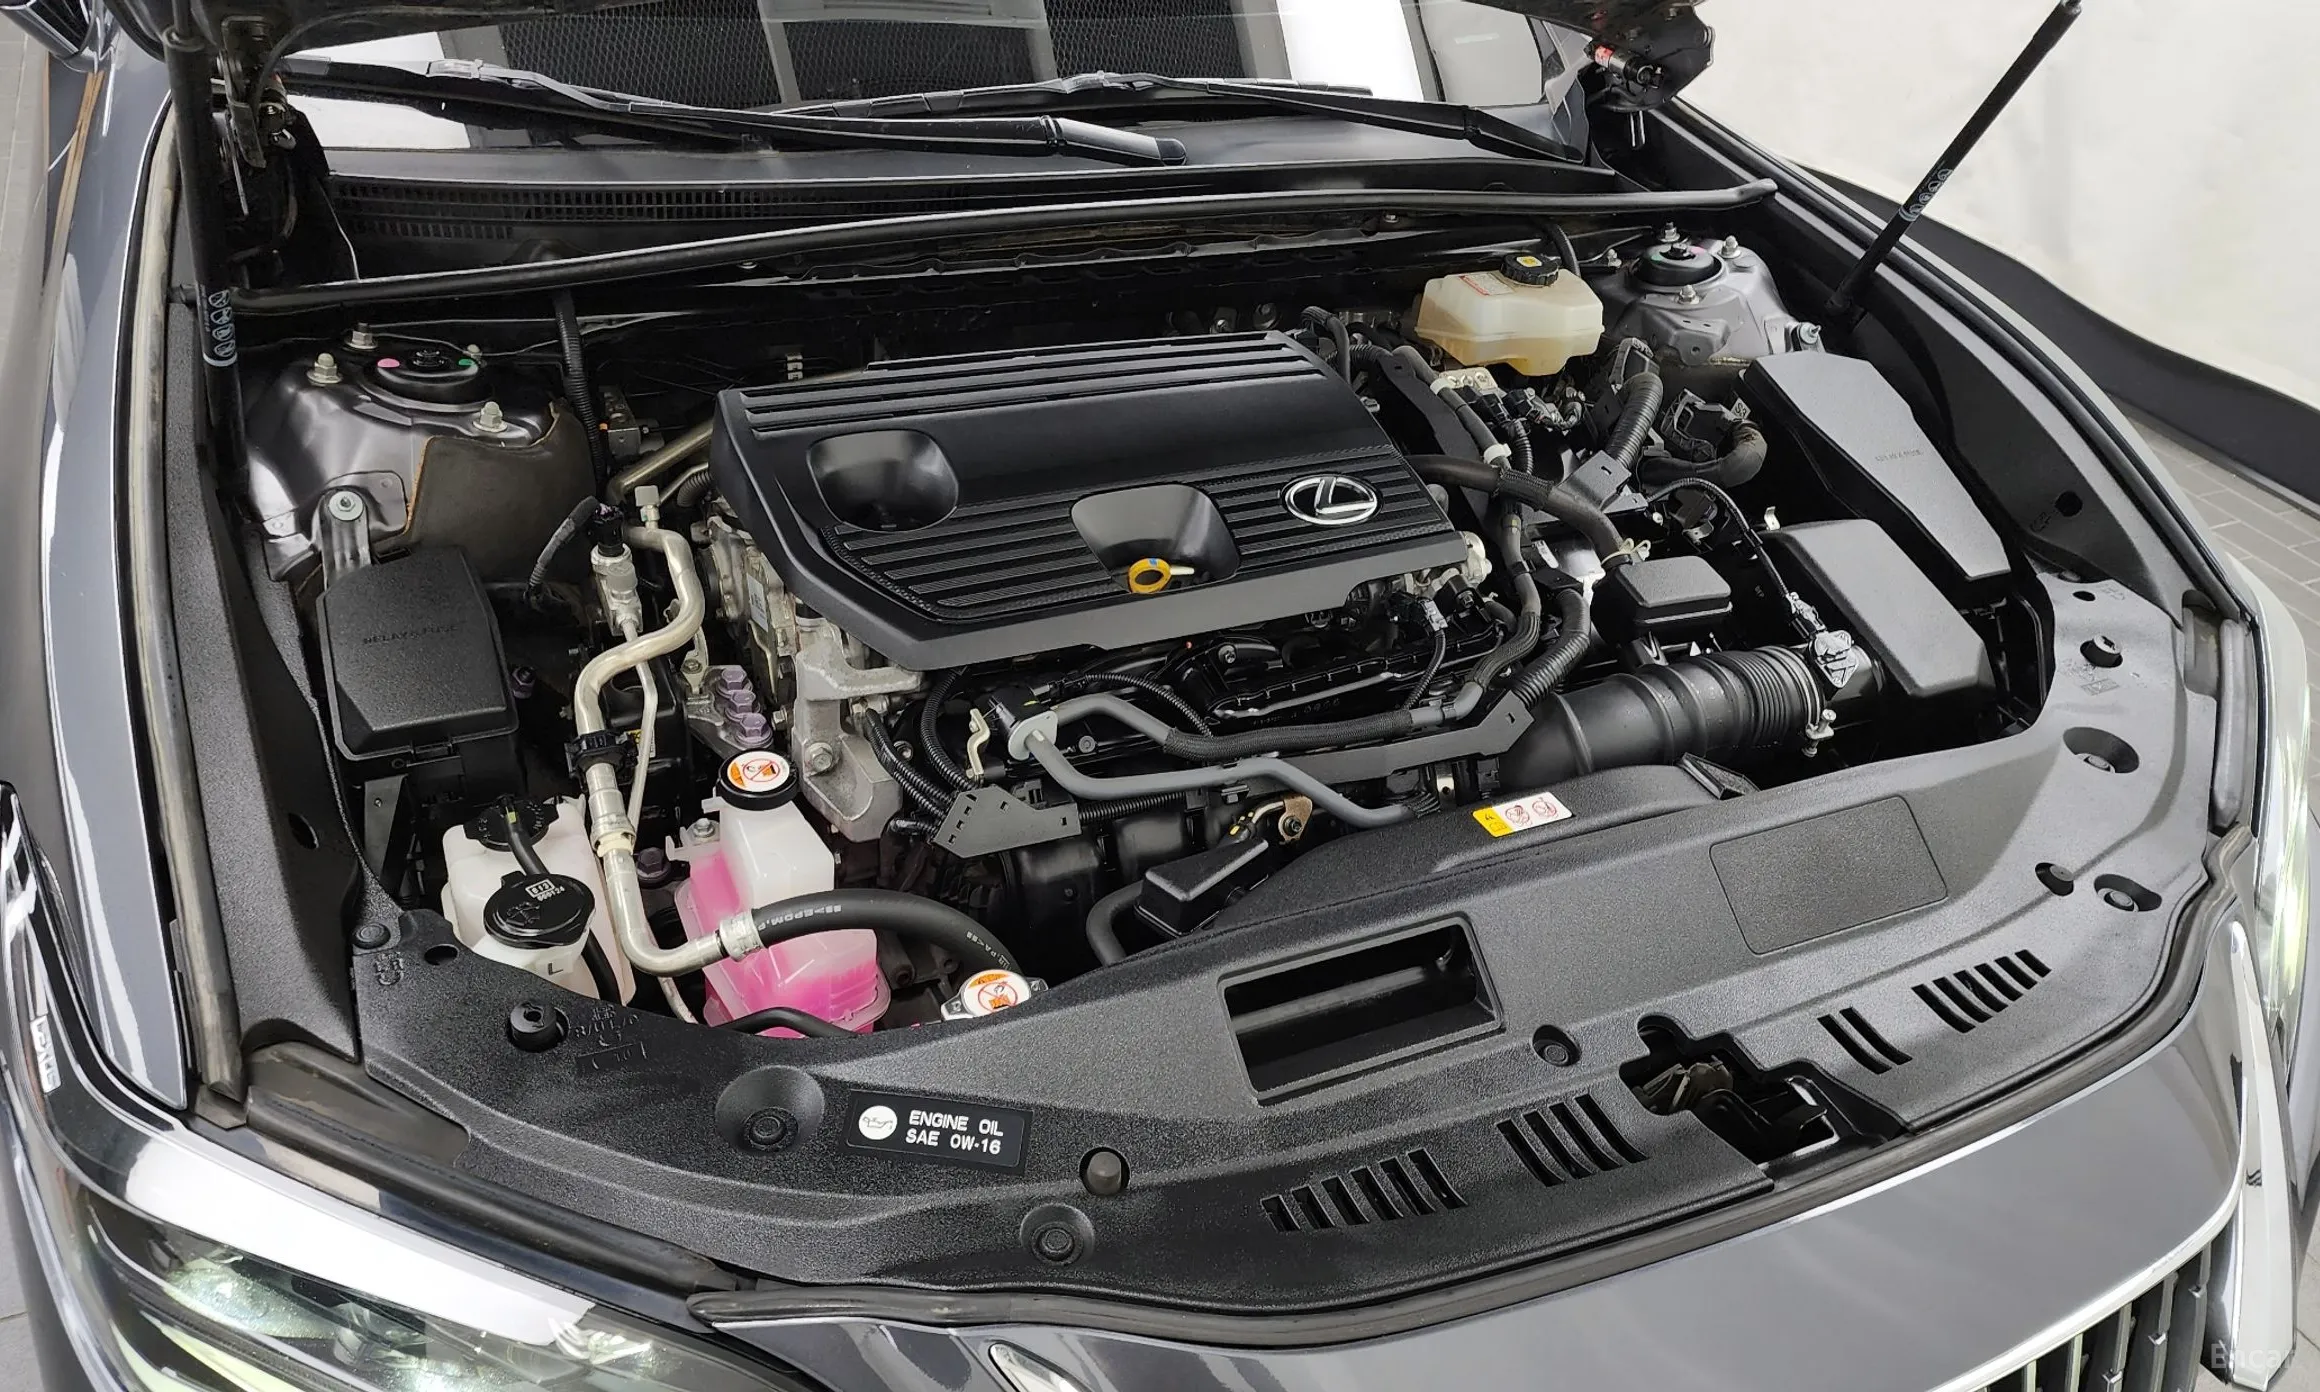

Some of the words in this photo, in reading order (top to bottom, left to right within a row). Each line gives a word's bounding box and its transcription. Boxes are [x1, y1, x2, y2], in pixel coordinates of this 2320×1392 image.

[909, 1110, 969, 1131] ENGINE
[978, 1119, 1004, 1137] OIL
[905, 1128, 940, 1146] SAE
